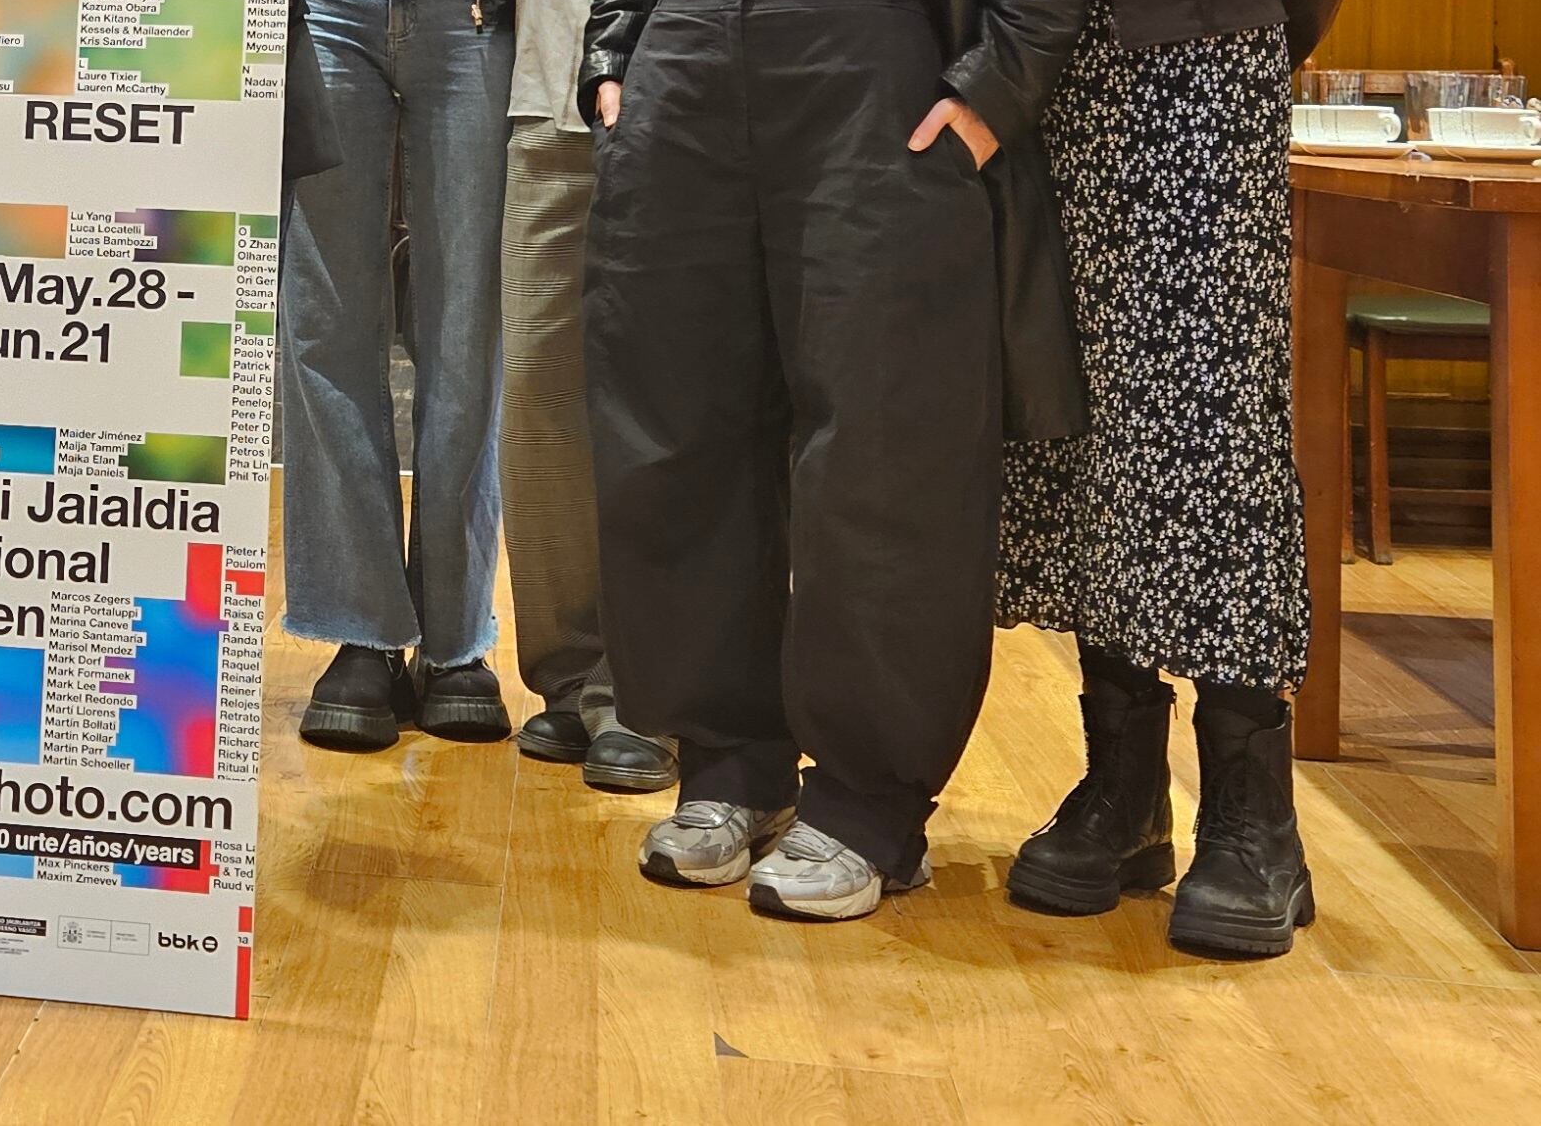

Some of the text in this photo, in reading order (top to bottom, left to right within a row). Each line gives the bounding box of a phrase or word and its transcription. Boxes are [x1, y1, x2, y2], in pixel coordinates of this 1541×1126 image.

[76, 82, 166, 96] Lauren McCarthy
[24, 100, 194, 144] RESET
[69, 222, 142, 234] Luca Locatelli
[68, 234, 154, 247] Lucas Bambozzi
[58, 427, 96, 439] Maider
[57, 464, 125, 477] Maja Daniels
[27, 481, 219, 532] Jaialdia
[50, 590, 131, 608] Marcos Zegers
[82, 605, 138, 621] Portaluppi
[48, 627, 80, 639] Mario
[46, 665, 131, 681] Mark Formanek
[46, 678, 96, 691] Mark Lee
[43, 741, 104, 755] Martin Parr
[42, 754, 131, 770] Martin Schoeller
[15, 832, 193, 864] urte/años/years
[158, 931, 198, 950] bbk
